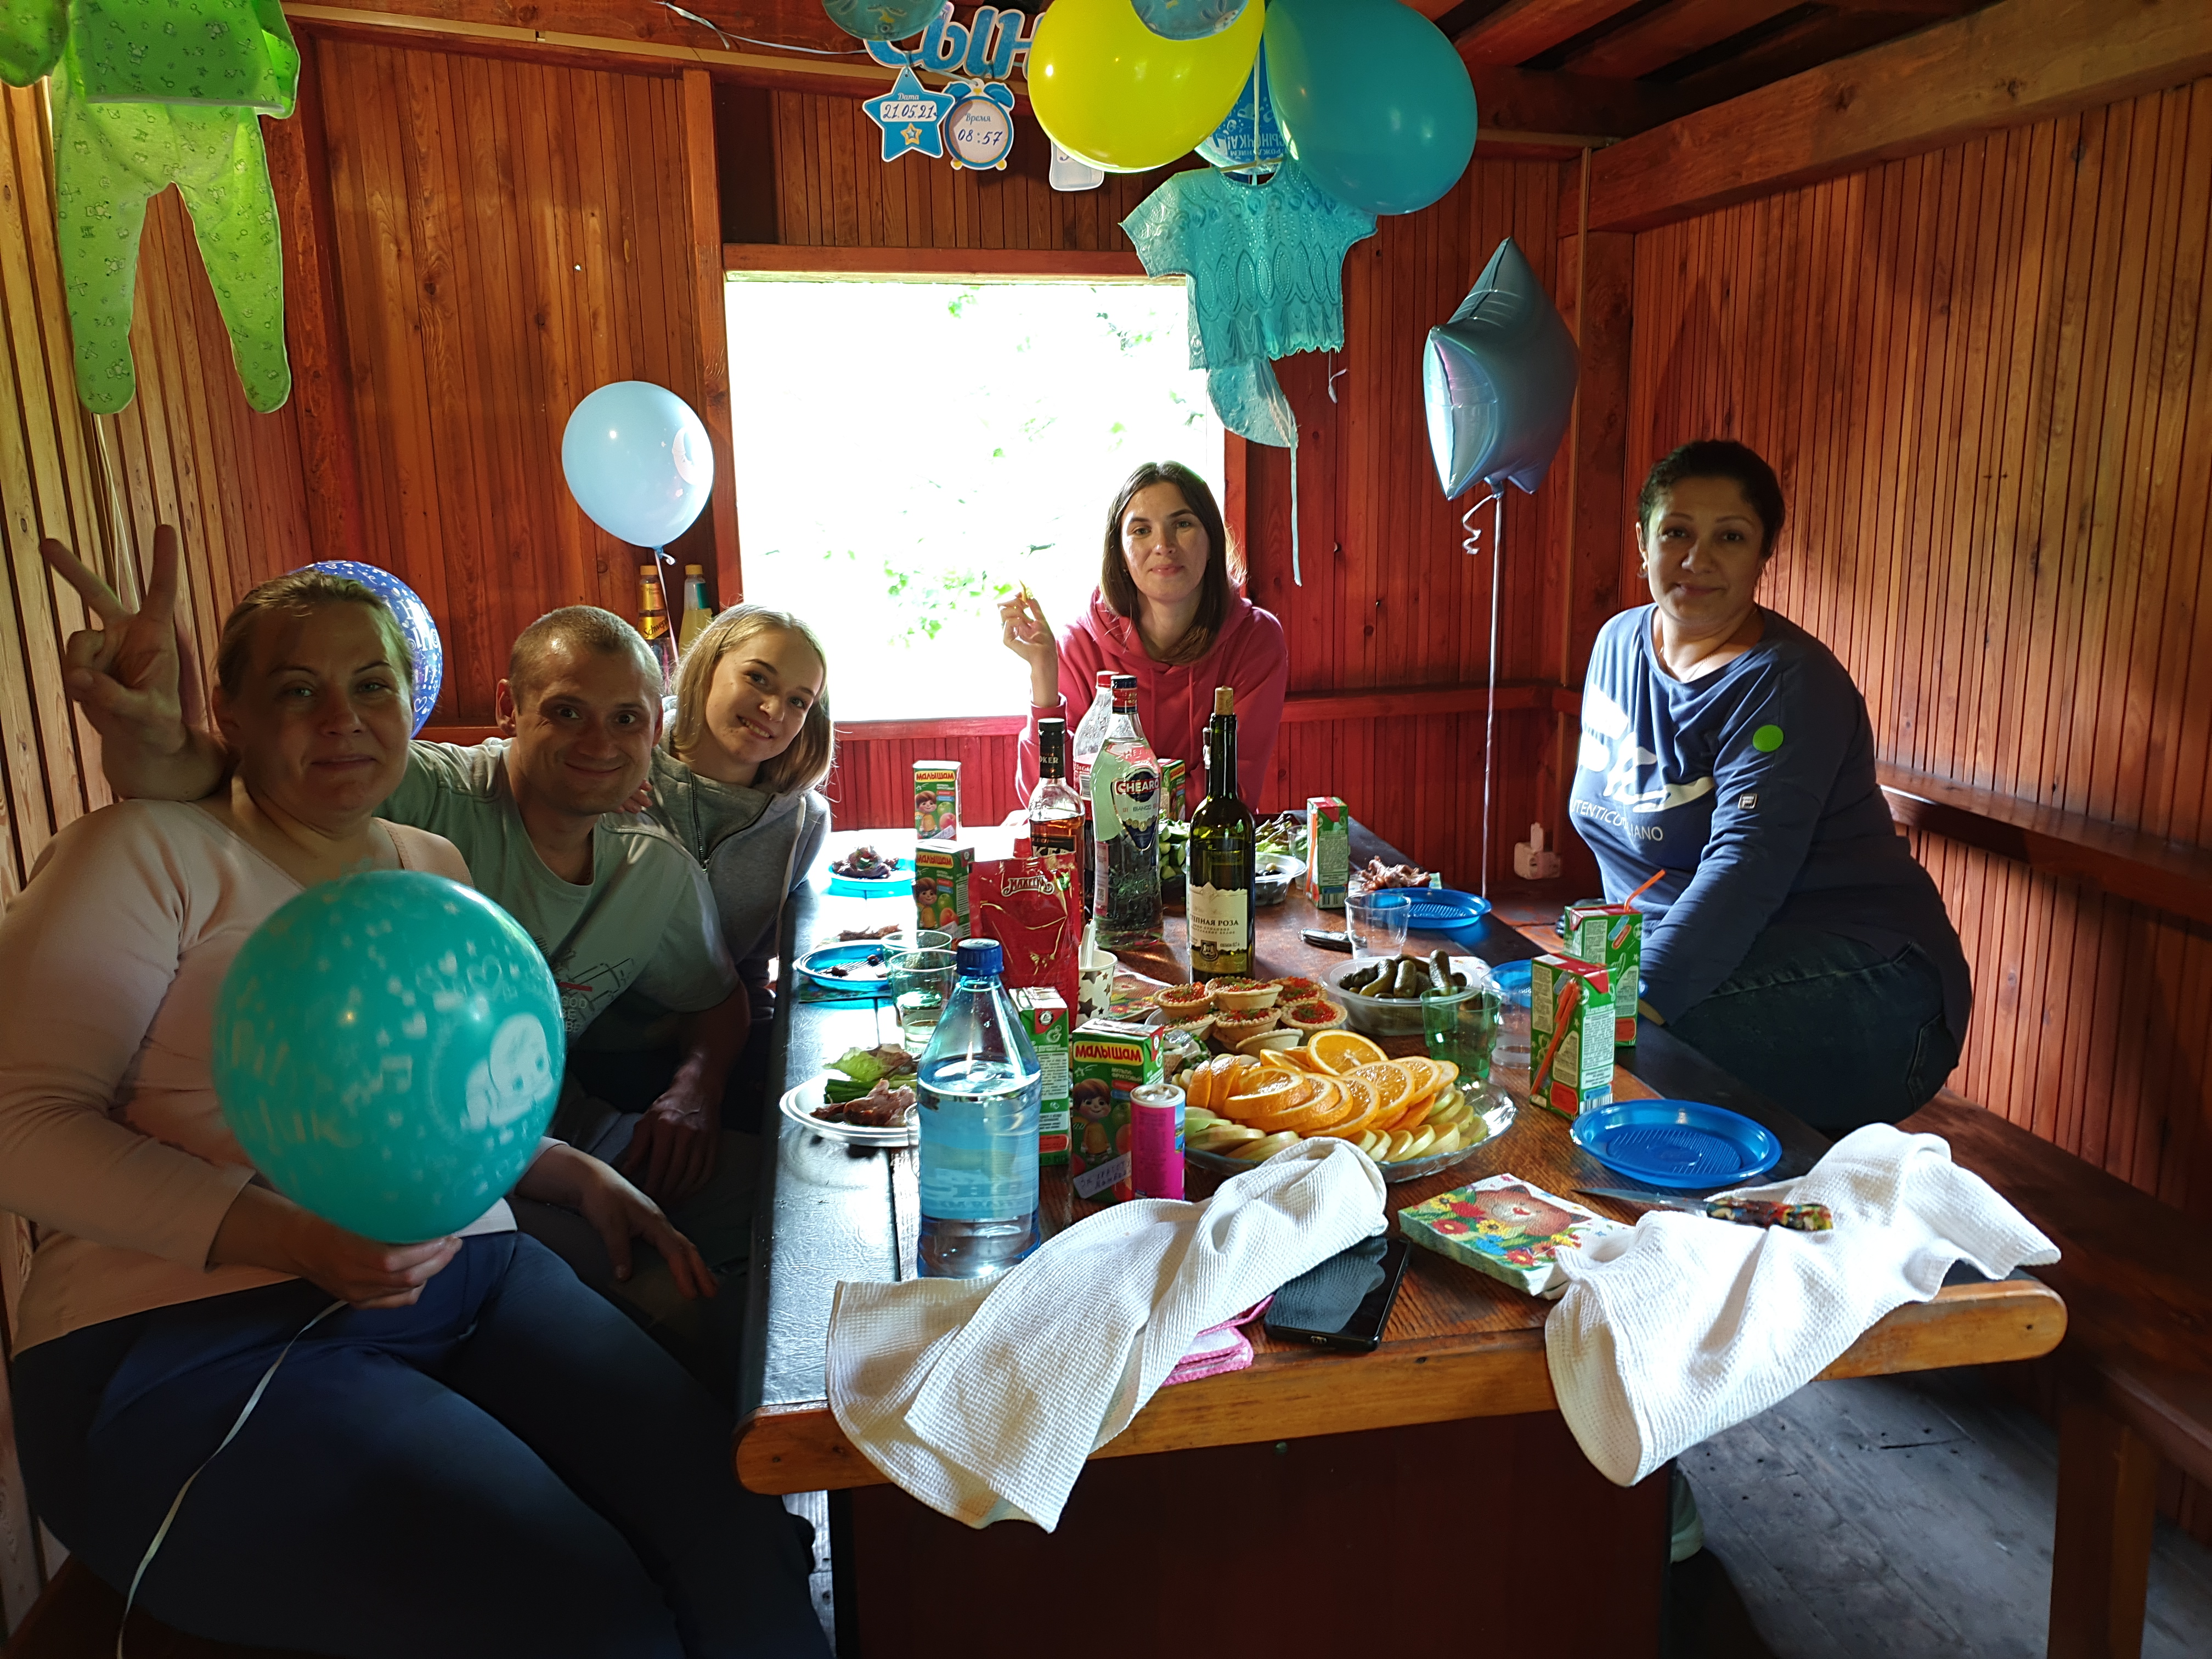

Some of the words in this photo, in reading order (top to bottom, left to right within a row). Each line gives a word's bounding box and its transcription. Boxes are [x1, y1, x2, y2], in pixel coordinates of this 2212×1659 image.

[897, 92, 919, 100] Дата
[965, 112, 991, 125] Время
[957, 128, 1003, 146] 08:57
[1190, 914, 1215, 926] ТЕПНАЯ
